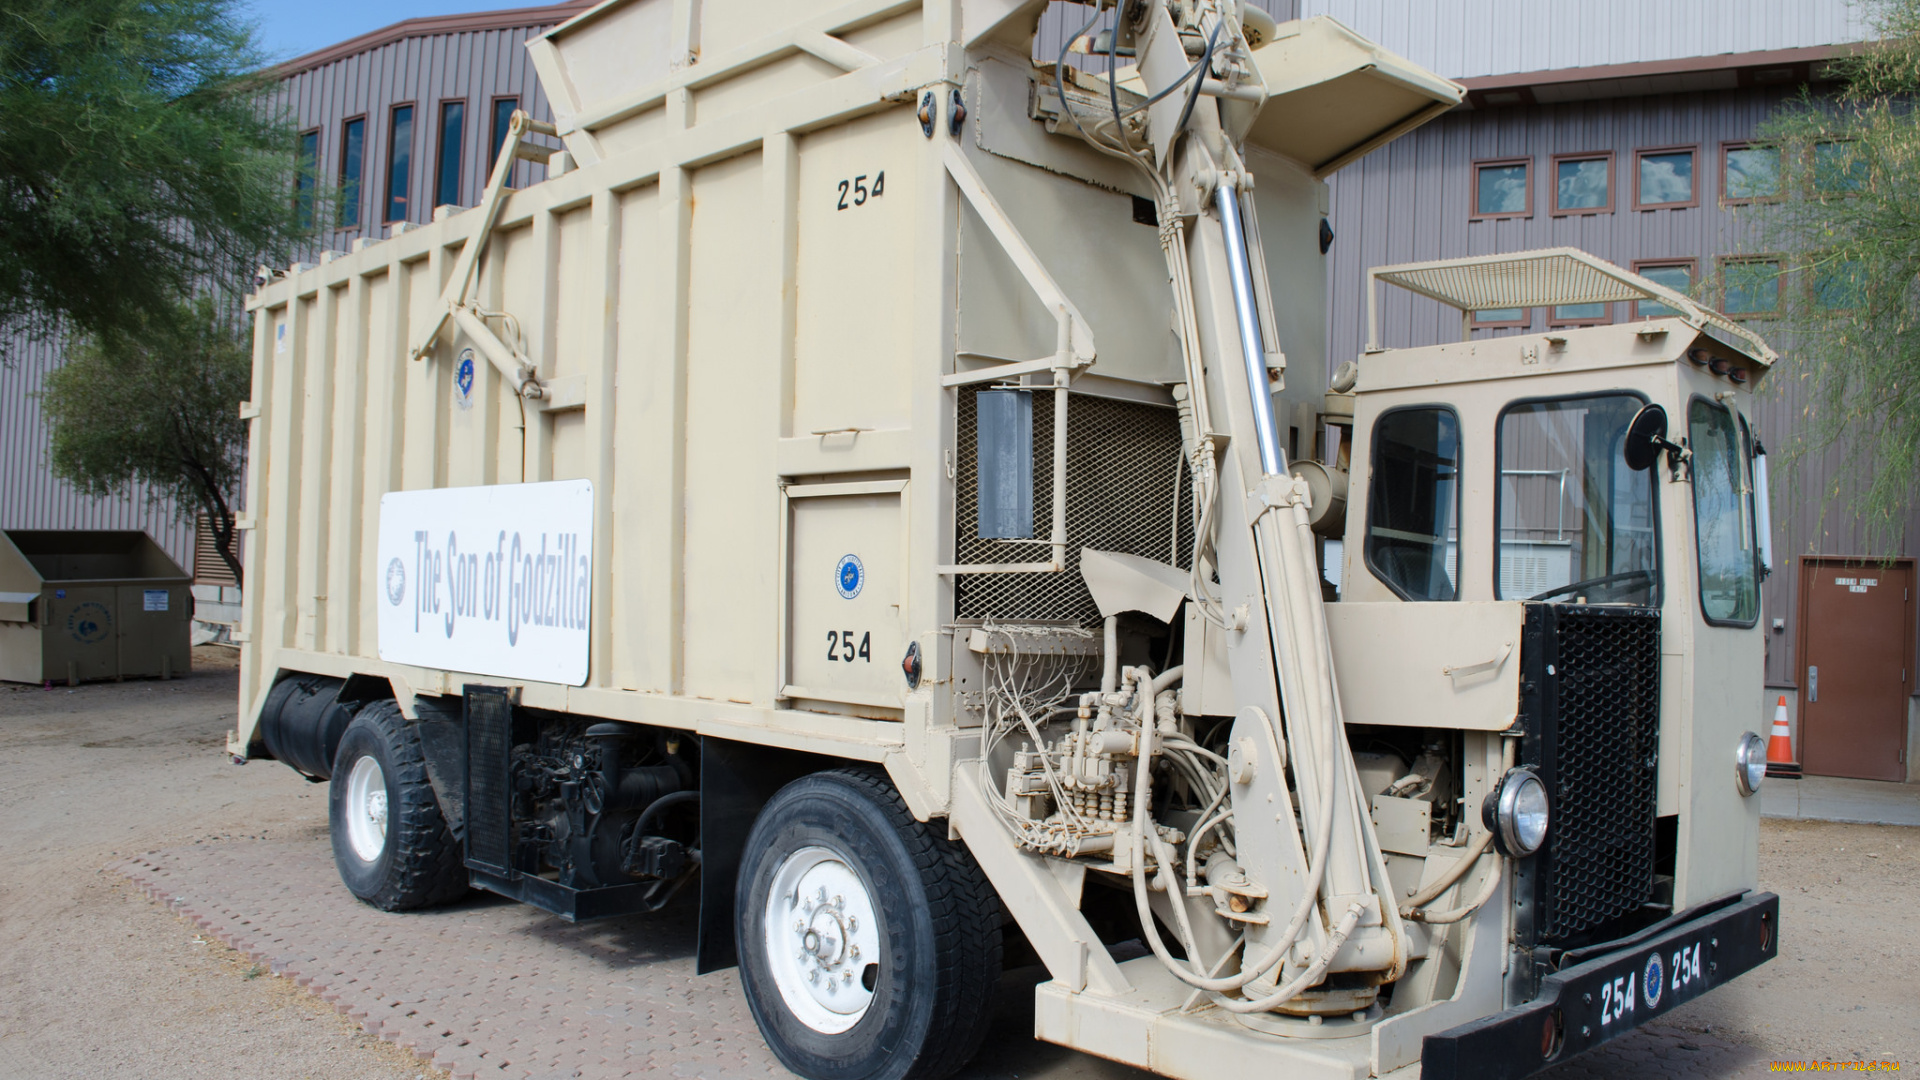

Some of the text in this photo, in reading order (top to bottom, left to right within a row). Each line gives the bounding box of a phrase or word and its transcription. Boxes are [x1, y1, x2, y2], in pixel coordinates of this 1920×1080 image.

[837, 170, 885, 211] 254
[414, 530, 441, 633] The
[445, 530, 478, 639] Son
[484, 529, 506, 621] of
[508, 531, 589, 647] Godzilla
[827, 630, 871, 663] 254
[1601, 971, 1635, 1026] 254
[1671, 942, 1701, 990] 254
